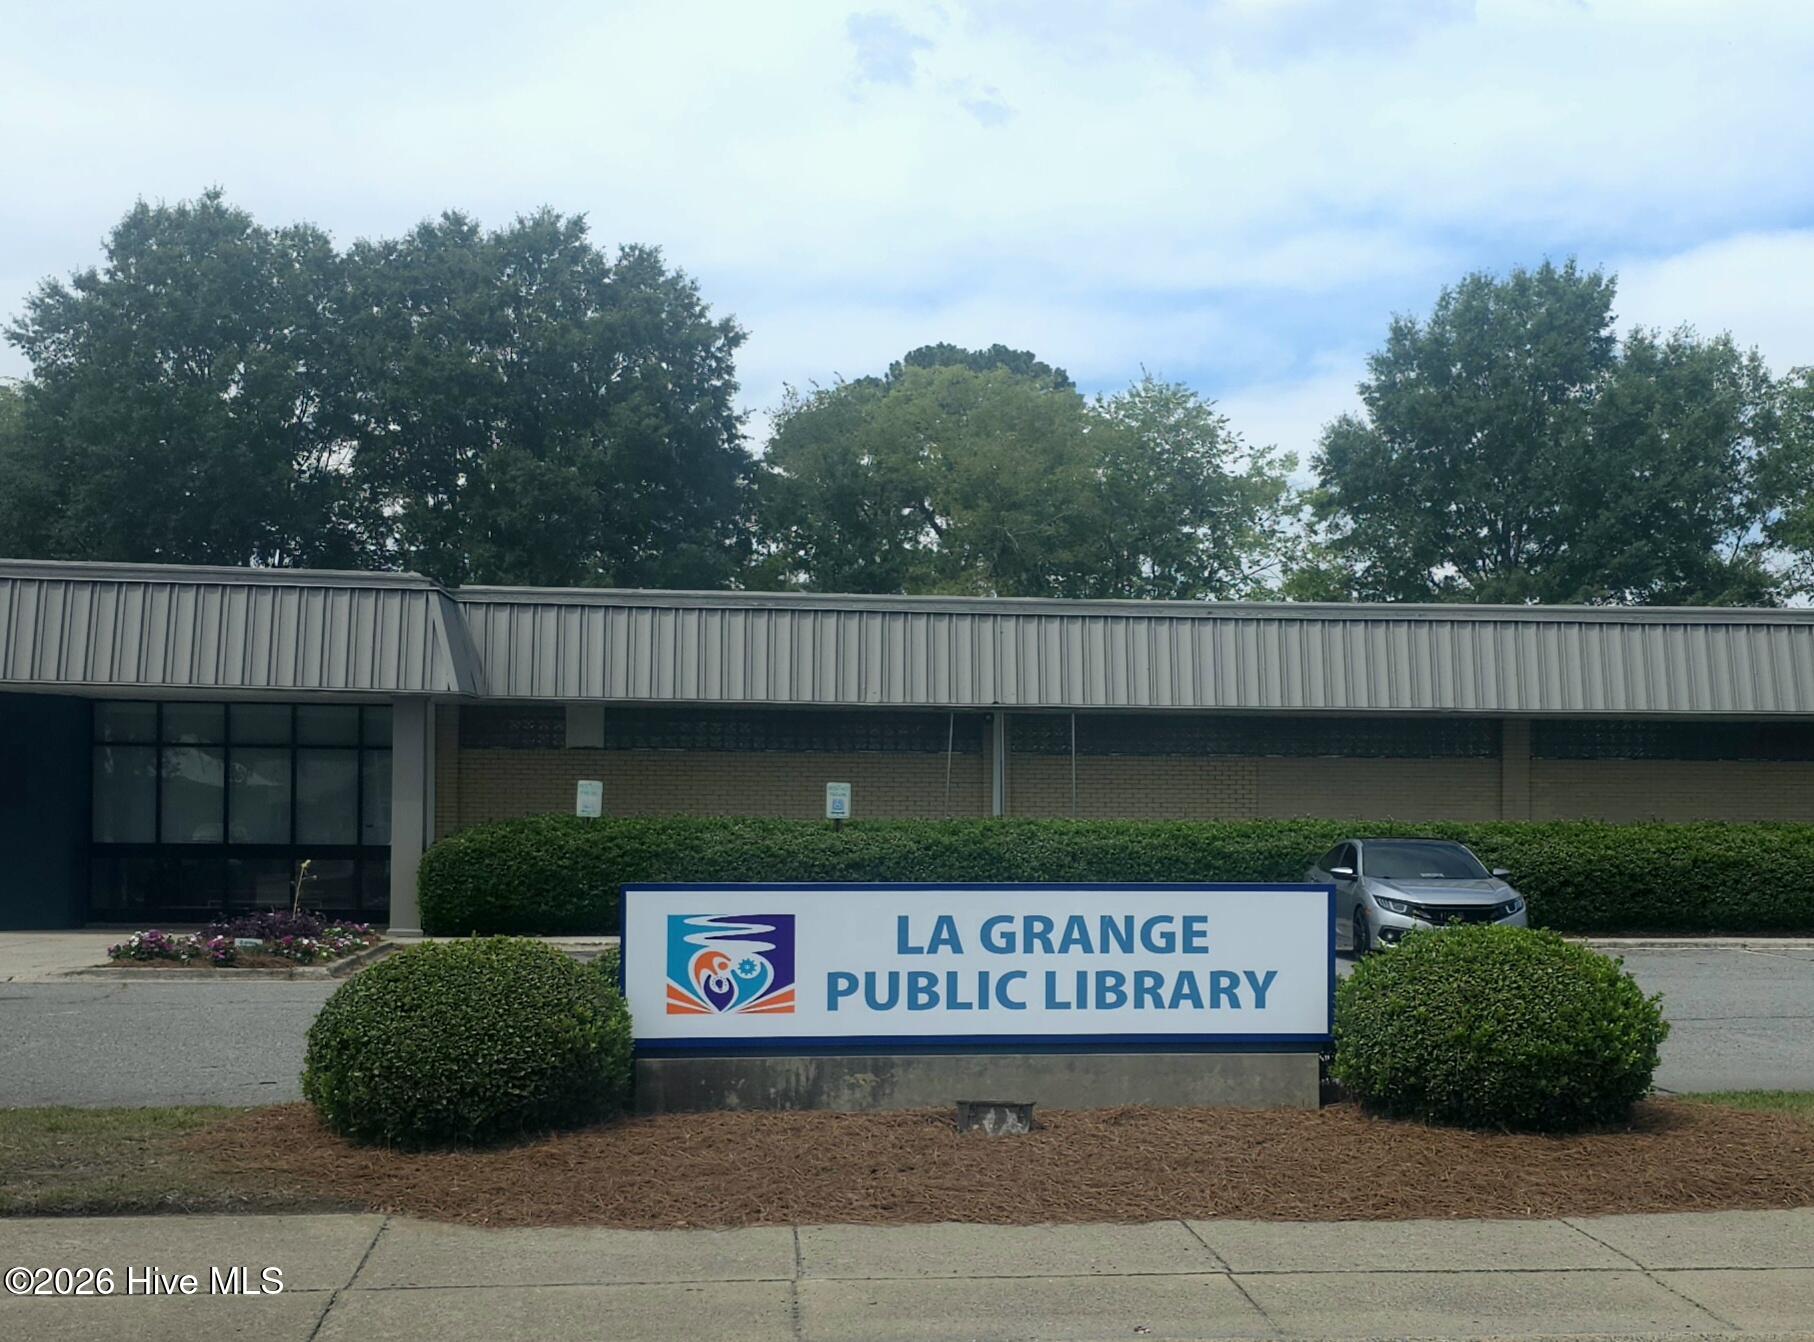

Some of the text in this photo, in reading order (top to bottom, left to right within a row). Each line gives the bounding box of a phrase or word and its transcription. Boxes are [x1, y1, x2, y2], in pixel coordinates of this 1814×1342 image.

[896, 914, 1210, 955] LA GRANGE
[826, 969, 1278, 1012] PUBLIC LIBRARY
